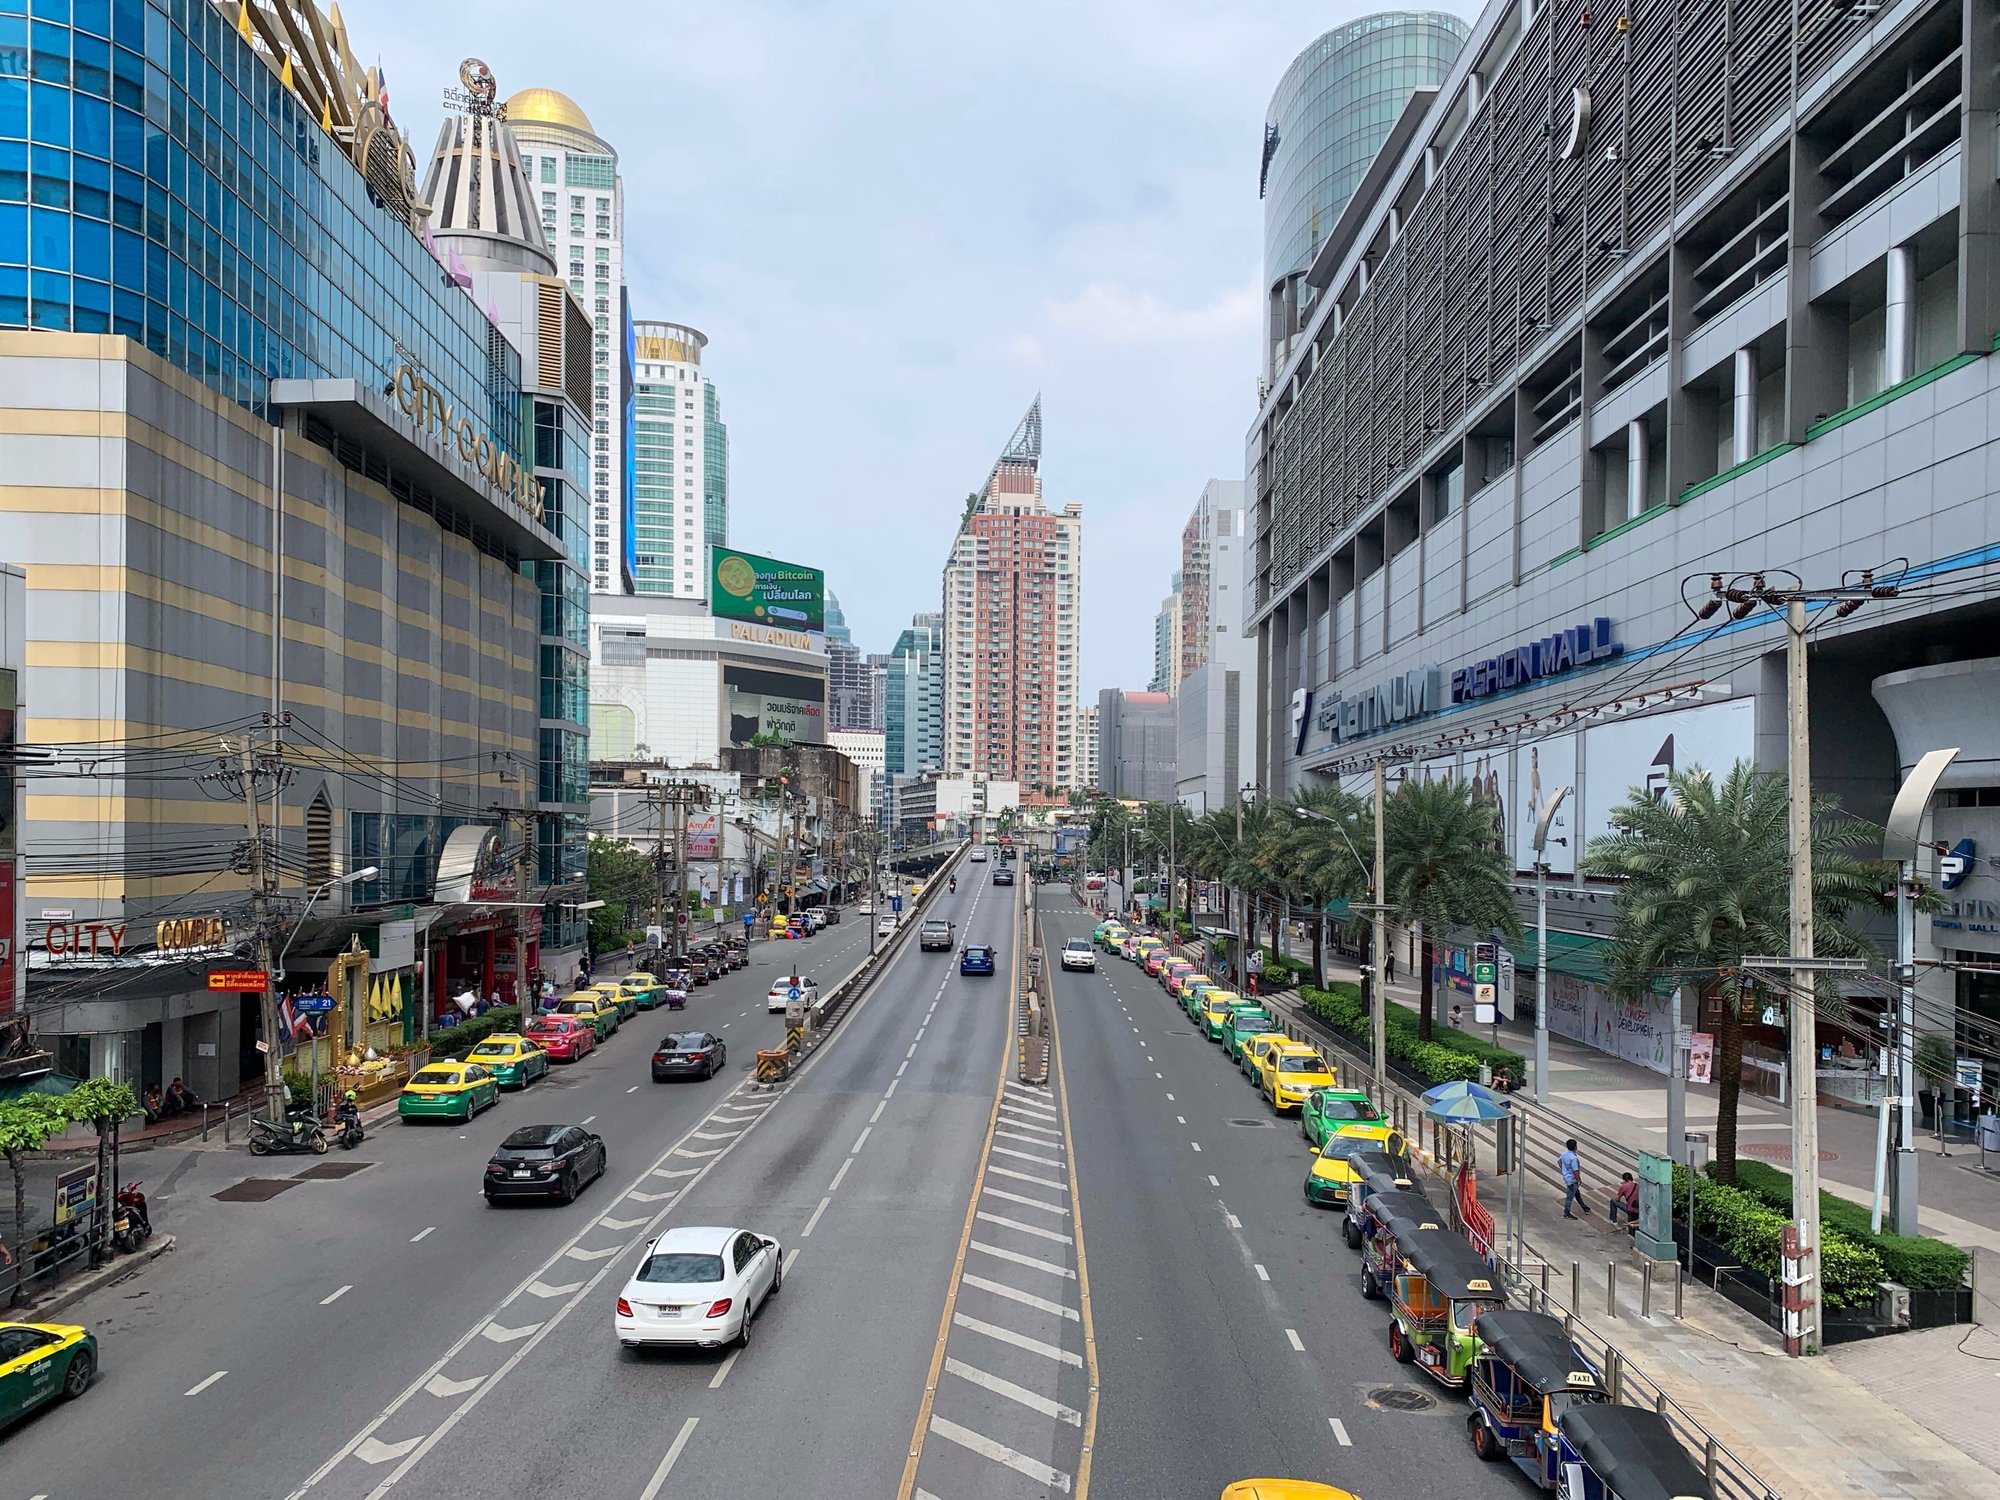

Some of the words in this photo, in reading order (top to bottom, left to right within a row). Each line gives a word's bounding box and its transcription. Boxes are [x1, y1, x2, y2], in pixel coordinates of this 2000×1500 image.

[443, 101, 463, 111] CITY
[395, 363, 453, 445] CITY
[457, 417, 546, 525] COMPLEX
[777, 570, 813, 580] Bitcoin
[763, 586, 812, 600] เปลี่ยนโลก
[731, 623, 810, 650] PALLADIUM
[1451, 642, 1543, 704] FASHION
[1540, 616, 1625, 676] MALL
[1326, 663, 1440, 744] PLATINUM
[46, 924, 128, 955] CITY
[156, 916, 228, 950] COMPLEX
[322, 999, 332, 1007] 21
[1618, 1017, 1654, 1039] DEVELOPMENT
[1573, 1374, 1591, 1382] TAXI
